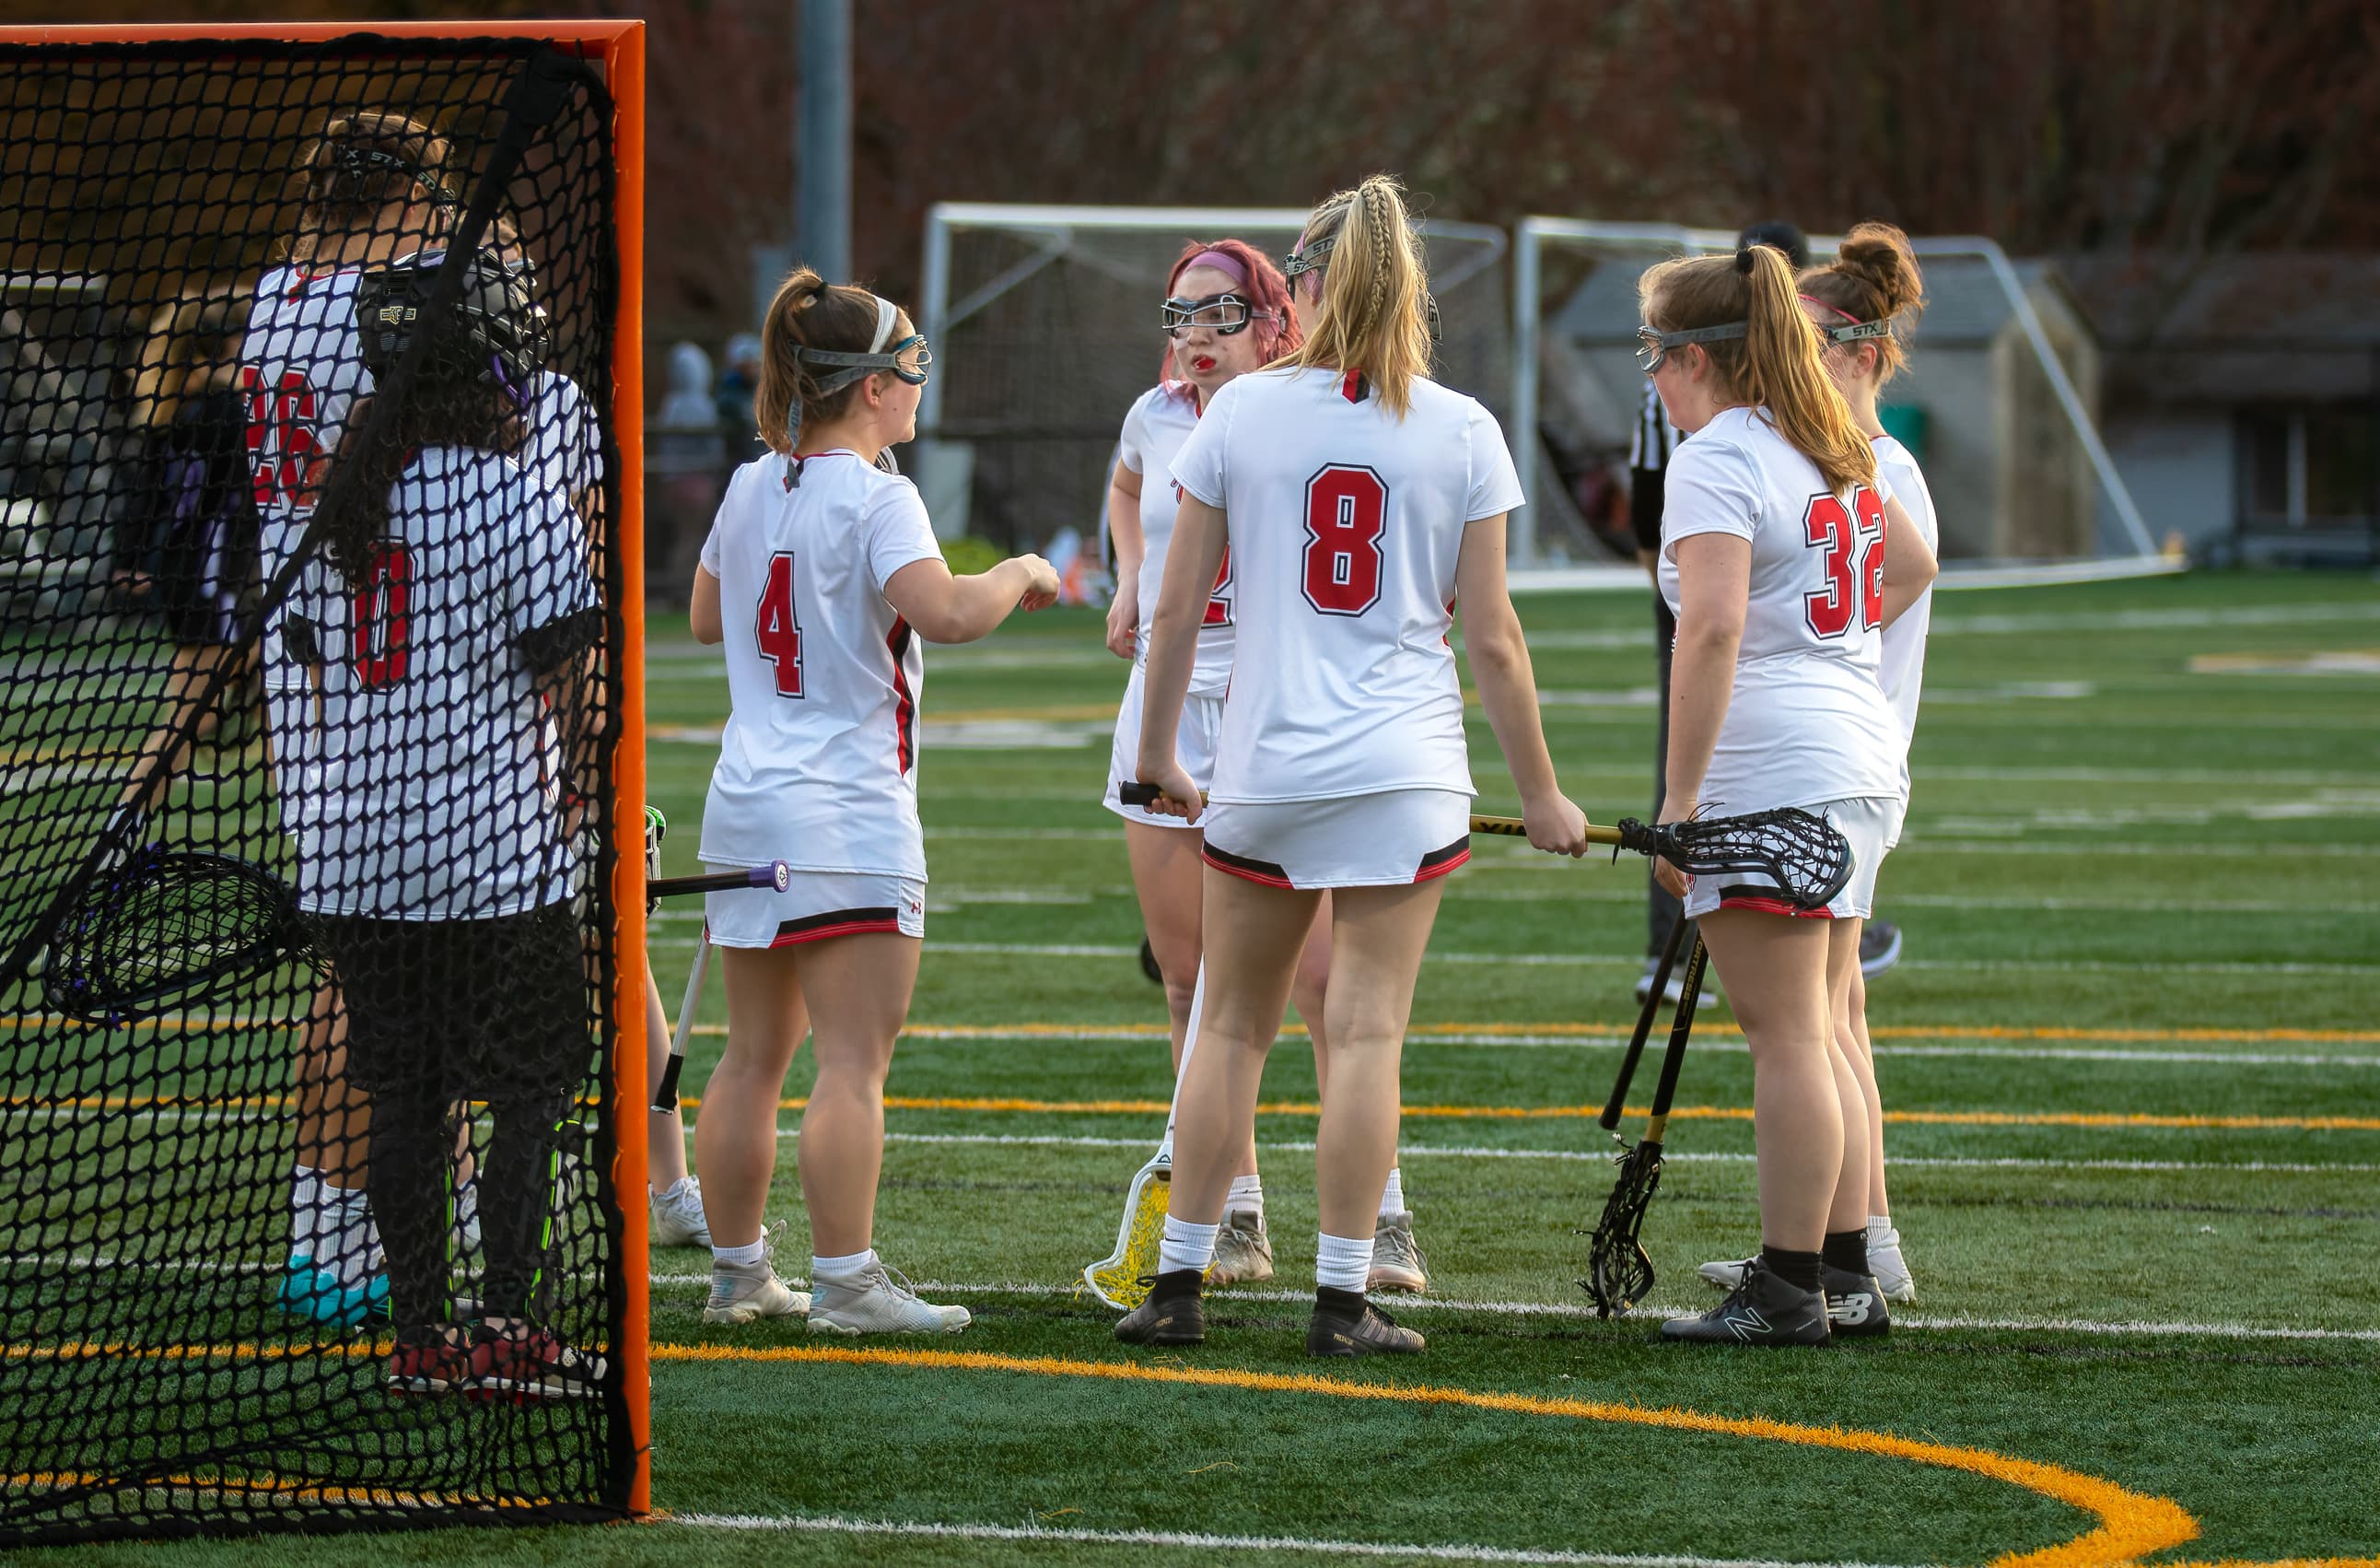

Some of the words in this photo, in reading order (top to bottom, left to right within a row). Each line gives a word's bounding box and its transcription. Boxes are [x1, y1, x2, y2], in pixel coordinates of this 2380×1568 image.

[1852, 322, 1878, 337] STX
[1301, 462, 1389, 617] 8
[1802, 484, 1887, 640] 32
[754, 551, 805, 700] 4
[1684, 940, 1704, 1000] ORTRESS
